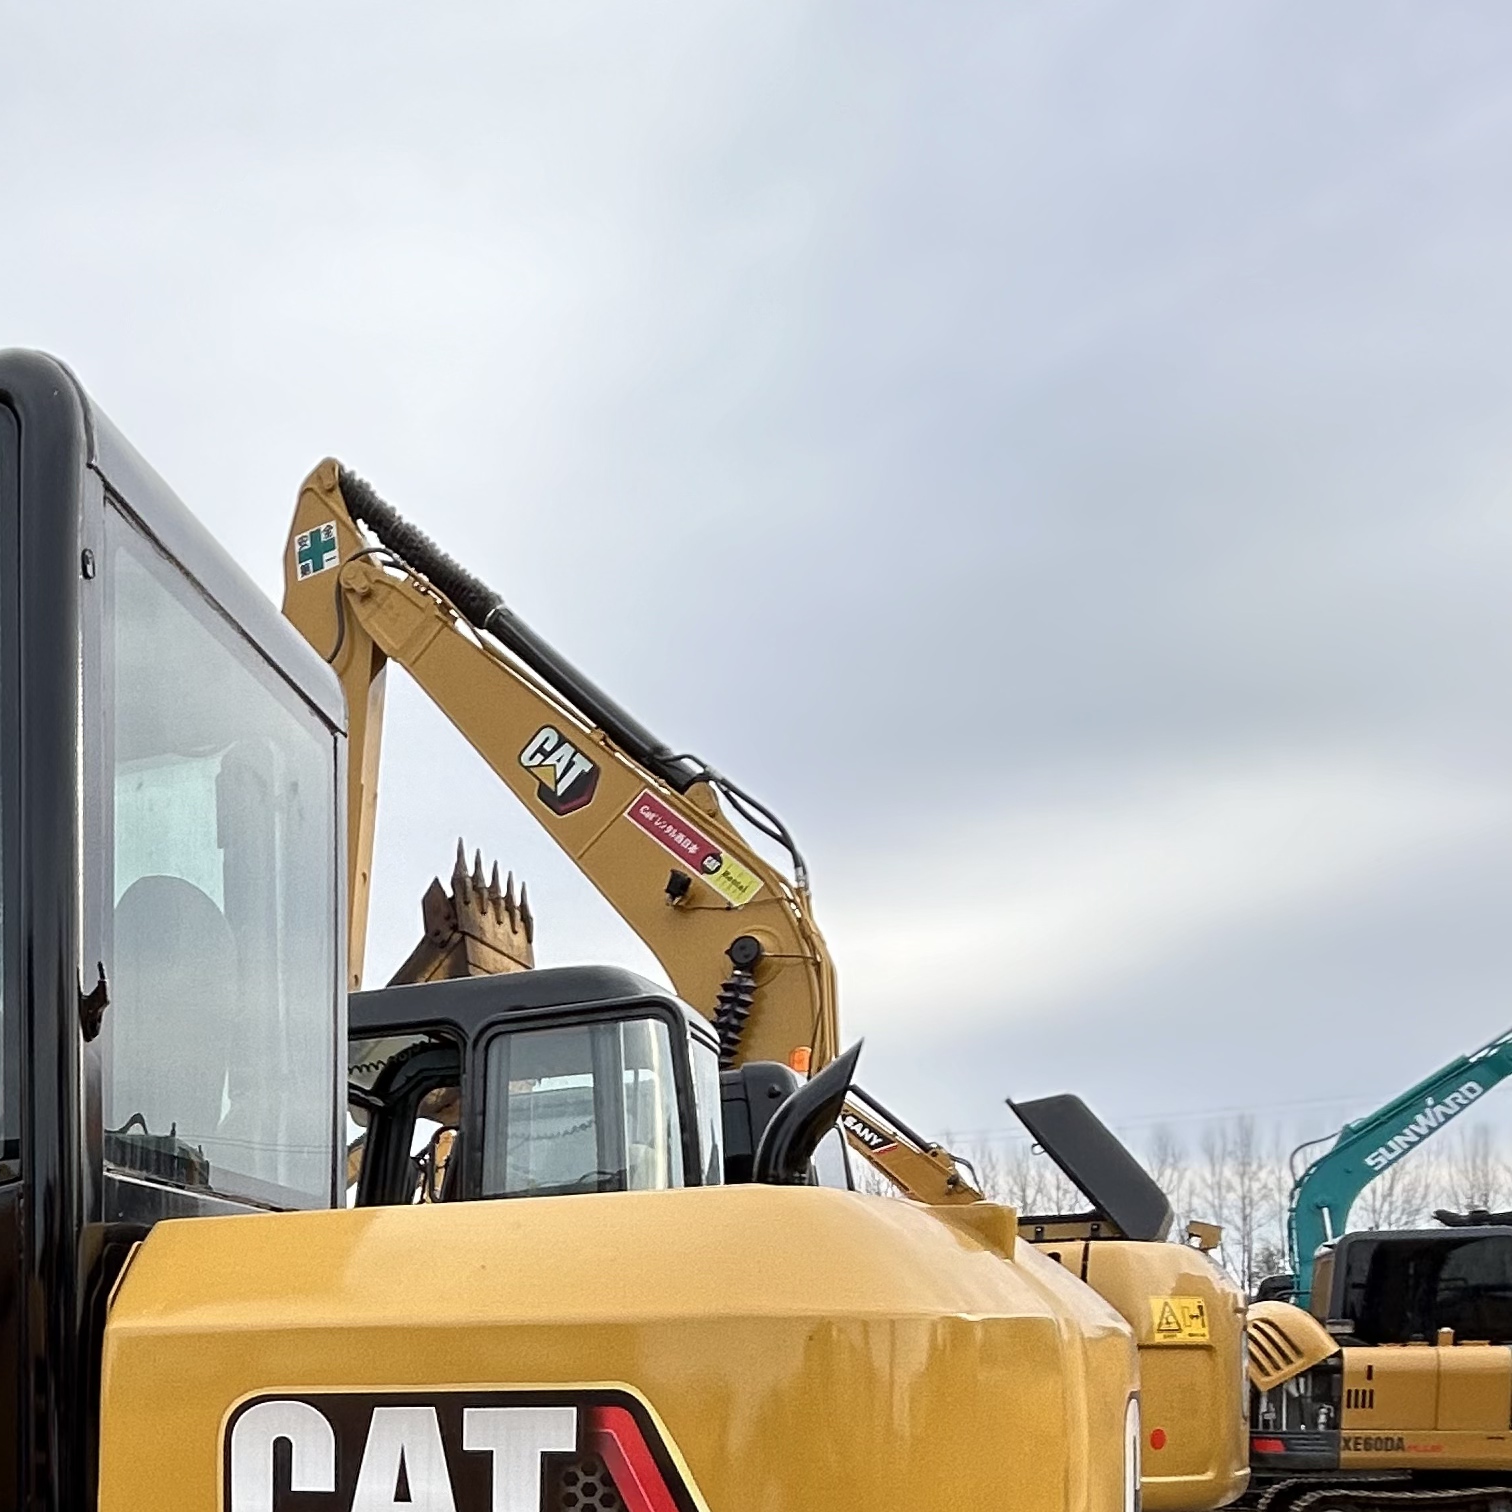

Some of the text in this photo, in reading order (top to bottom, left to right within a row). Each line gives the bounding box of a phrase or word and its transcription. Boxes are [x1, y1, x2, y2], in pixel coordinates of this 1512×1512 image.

[520, 726, 594, 797] CAT
[843, 1115, 883, 1146] SANY
[1364, 1080, 1485, 1171] SUNWARD
[1342, 1436, 1405, 1452] XE60DA
